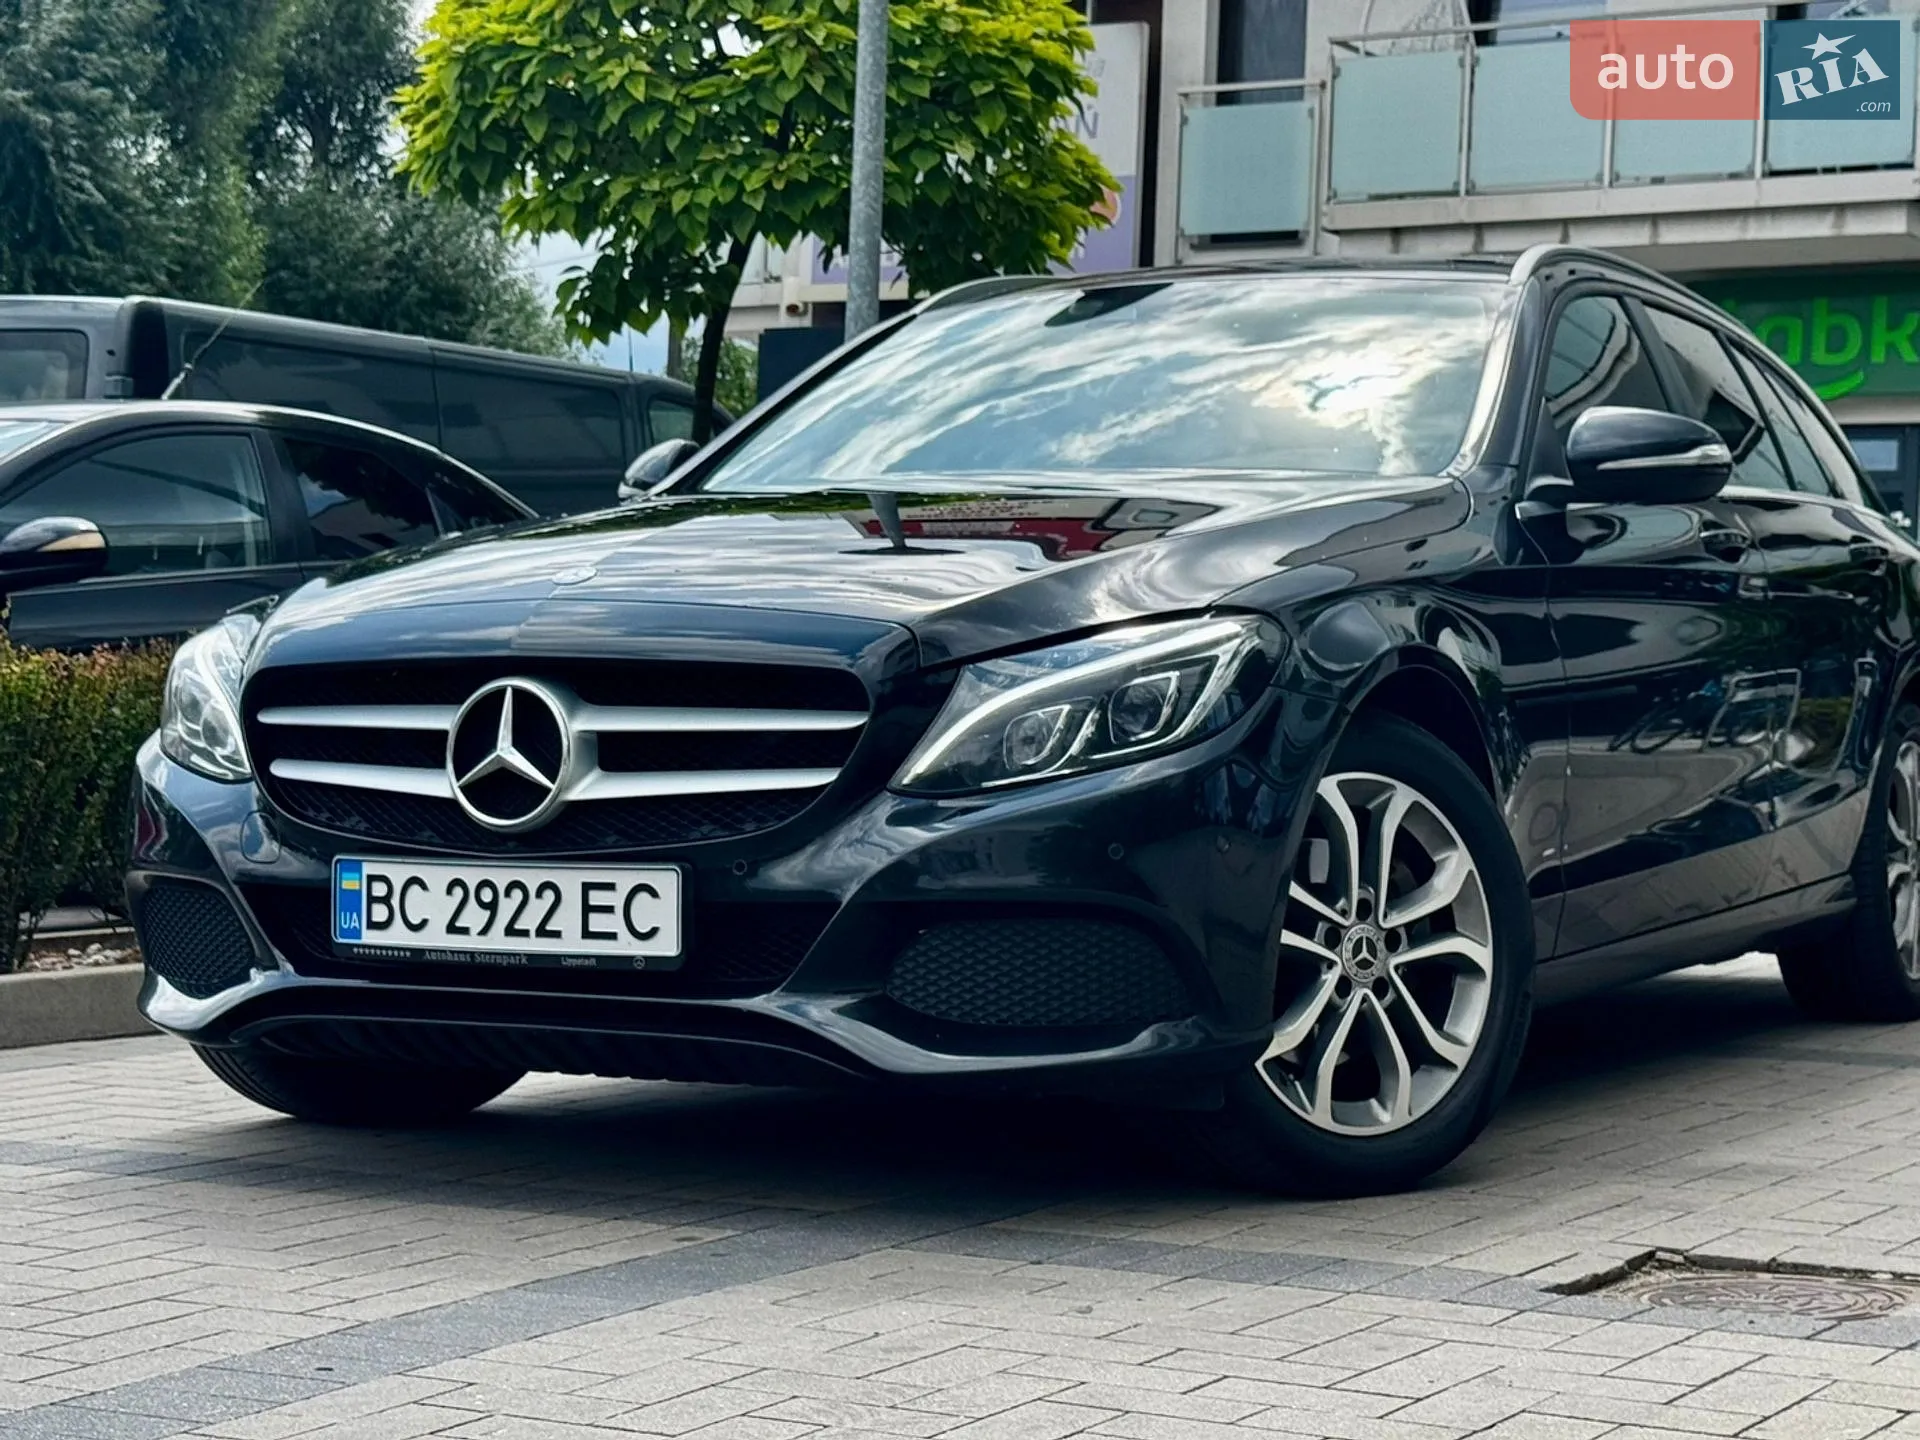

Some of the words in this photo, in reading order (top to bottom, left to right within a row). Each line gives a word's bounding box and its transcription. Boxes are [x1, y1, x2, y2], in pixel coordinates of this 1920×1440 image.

[365, 873, 431, 933] BC
[444, 877, 564, 939] 2922
[580, 880, 662, 942] EC
[341, 911, 360, 930] UA
[423, 950, 472, 962] Autohaus
[474, 951, 529, 966] Sternpark
